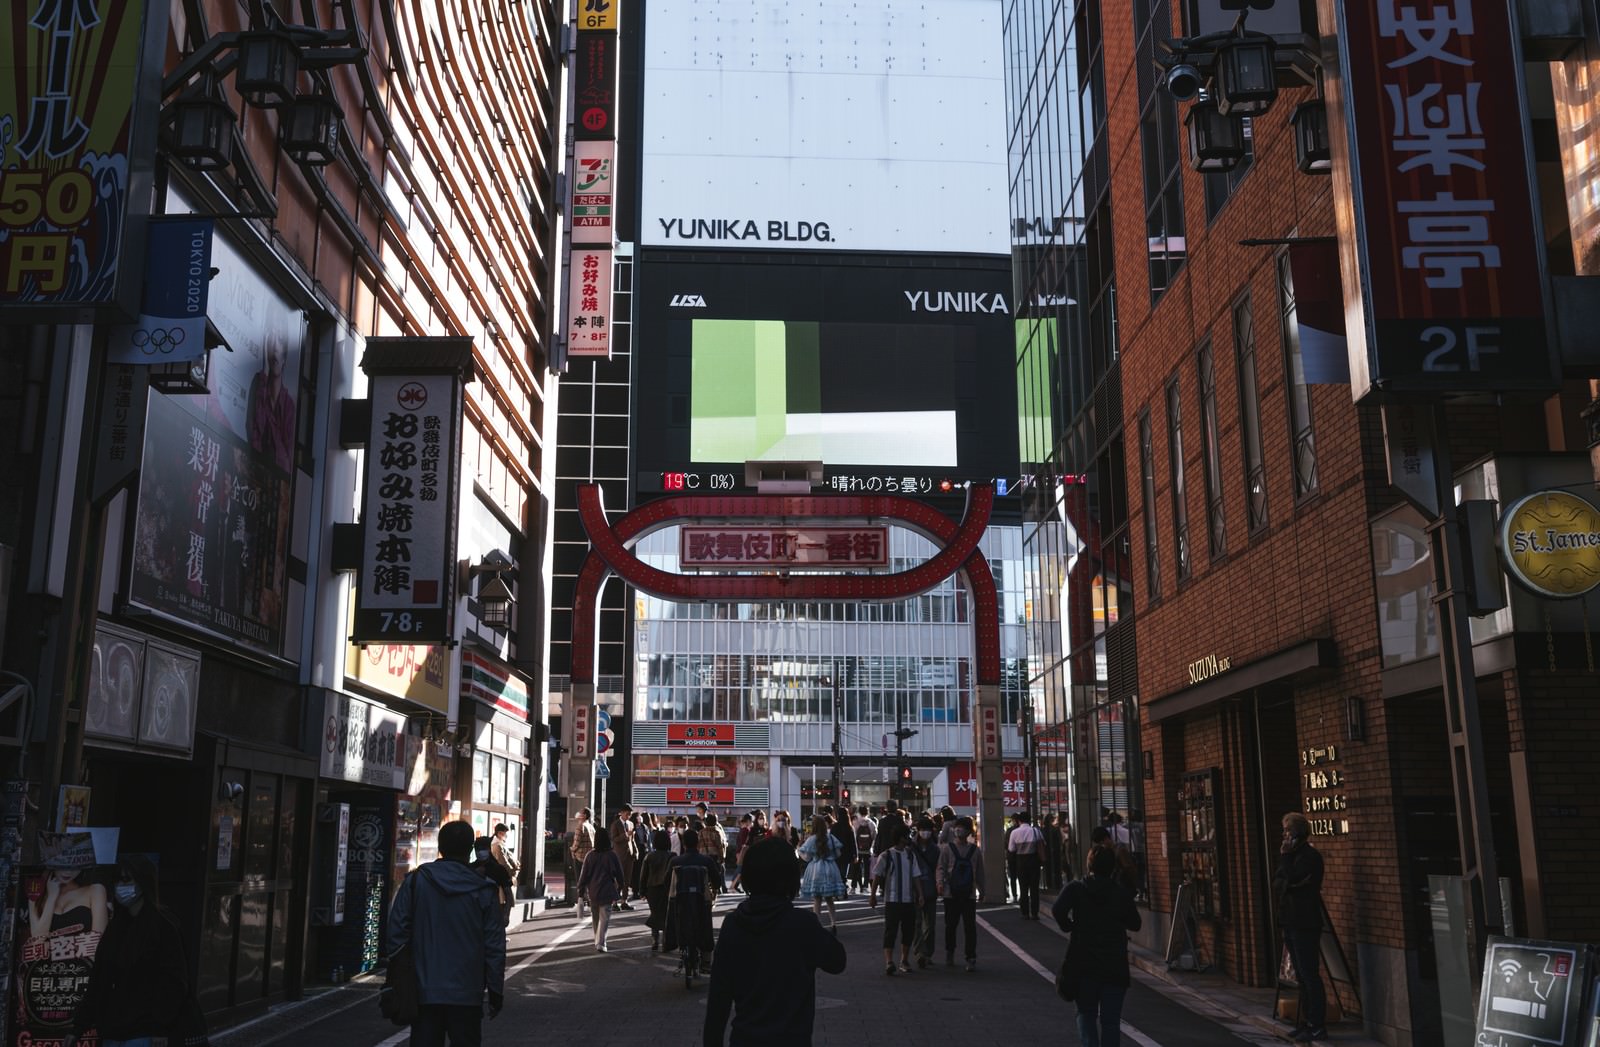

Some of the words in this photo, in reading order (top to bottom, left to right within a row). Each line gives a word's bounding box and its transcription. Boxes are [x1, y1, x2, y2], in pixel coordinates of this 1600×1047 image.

[586, 15, 607, 28] 6F
[1377, 0, 1502, 289] 安楽亭
[579, 196, 606, 204] たばこ
[580, 217, 603, 226] ATM
[659, 218, 761, 240] YUNIKA
[767, 221, 836, 242] BLDG.
[6, 236, 70, 294] 円
[189, 229, 206, 277] TOKYO
[186, 278, 202, 314] 2020
[582, 255, 599, 311] お好み焼
[904, 290, 1009, 314] YUNIKA
[573, 316, 605, 329] 本陣
[1419, 326, 1502, 373] 2F
[231, 475, 257, 512] 全ての
[374, 412, 419, 596] お好み焼本陣
[689, 532, 881, 561] 歌舞伎町一番街
[1188, 653, 1220, 685] SUZUYA
[348, 848, 385, 863] BOSS
